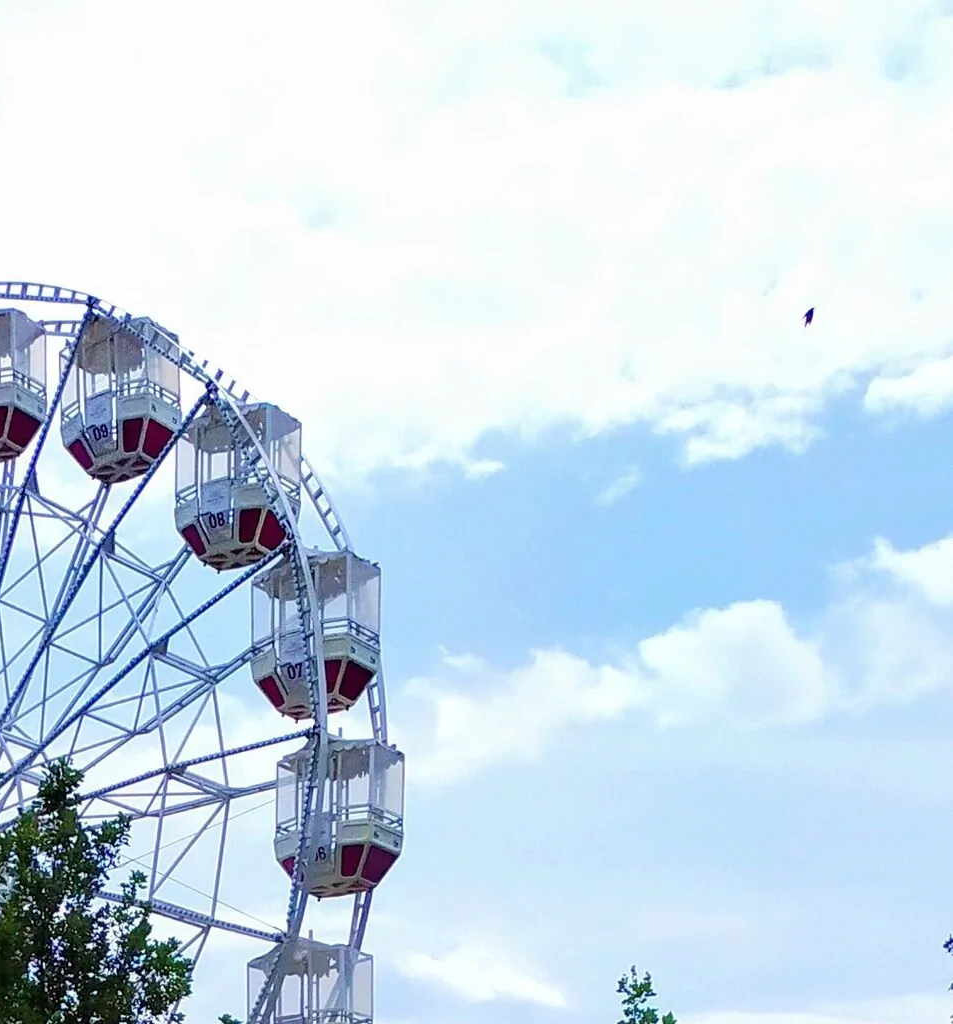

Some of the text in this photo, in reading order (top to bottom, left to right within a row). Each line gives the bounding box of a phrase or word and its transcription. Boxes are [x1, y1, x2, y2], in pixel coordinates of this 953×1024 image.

[92, 423, 109, 441] 09
[208, 511, 226, 529] 08
[287, 662, 303, 680] 07
